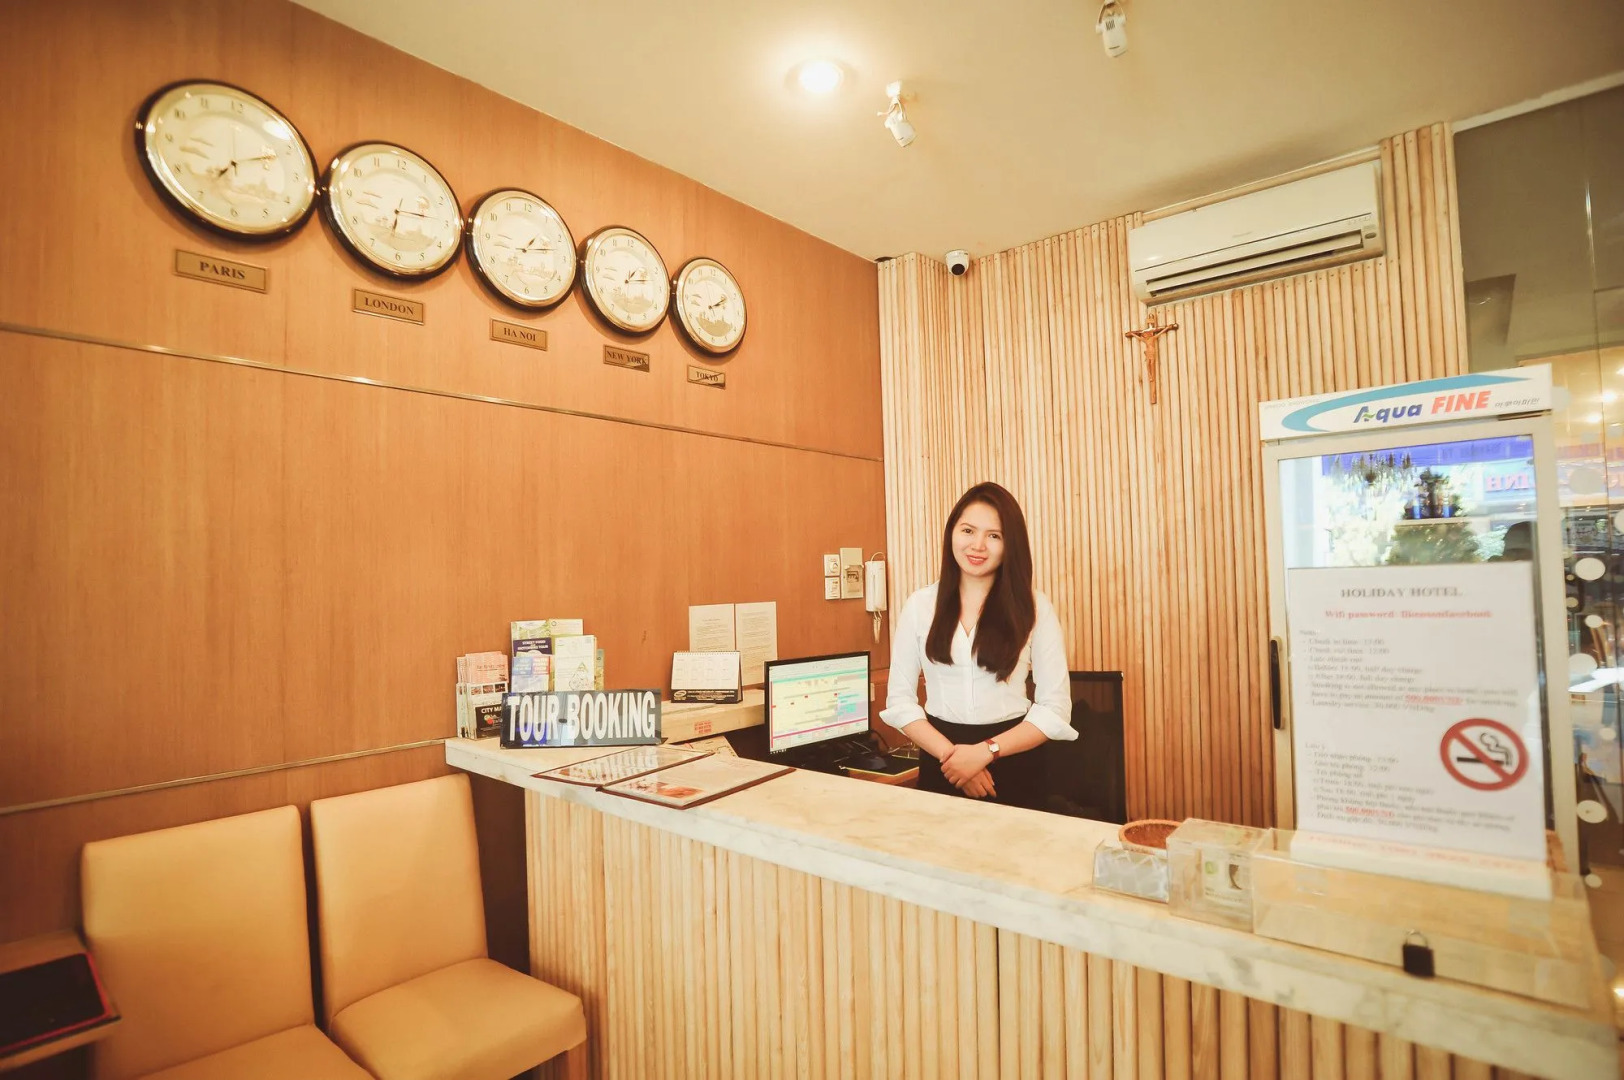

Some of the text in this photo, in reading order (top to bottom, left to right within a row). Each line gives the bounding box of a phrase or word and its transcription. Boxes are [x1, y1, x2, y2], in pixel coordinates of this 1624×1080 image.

[397, 159, 407, 171] 12
[524, 203, 533, 213] 12
[200, 260, 246, 280] PARIS
[364, 297, 414, 315] LONDON
[503, 327, 537, 342] HA NOI
[606, 350, 648, 365] NEW YORK
[1353, 390, 1492, 424] Aqua FINE
[1341, 586, 1463, 598] HOLIDAY HOTEL
[508, 691, 656, 742] TOUR BOOKING
